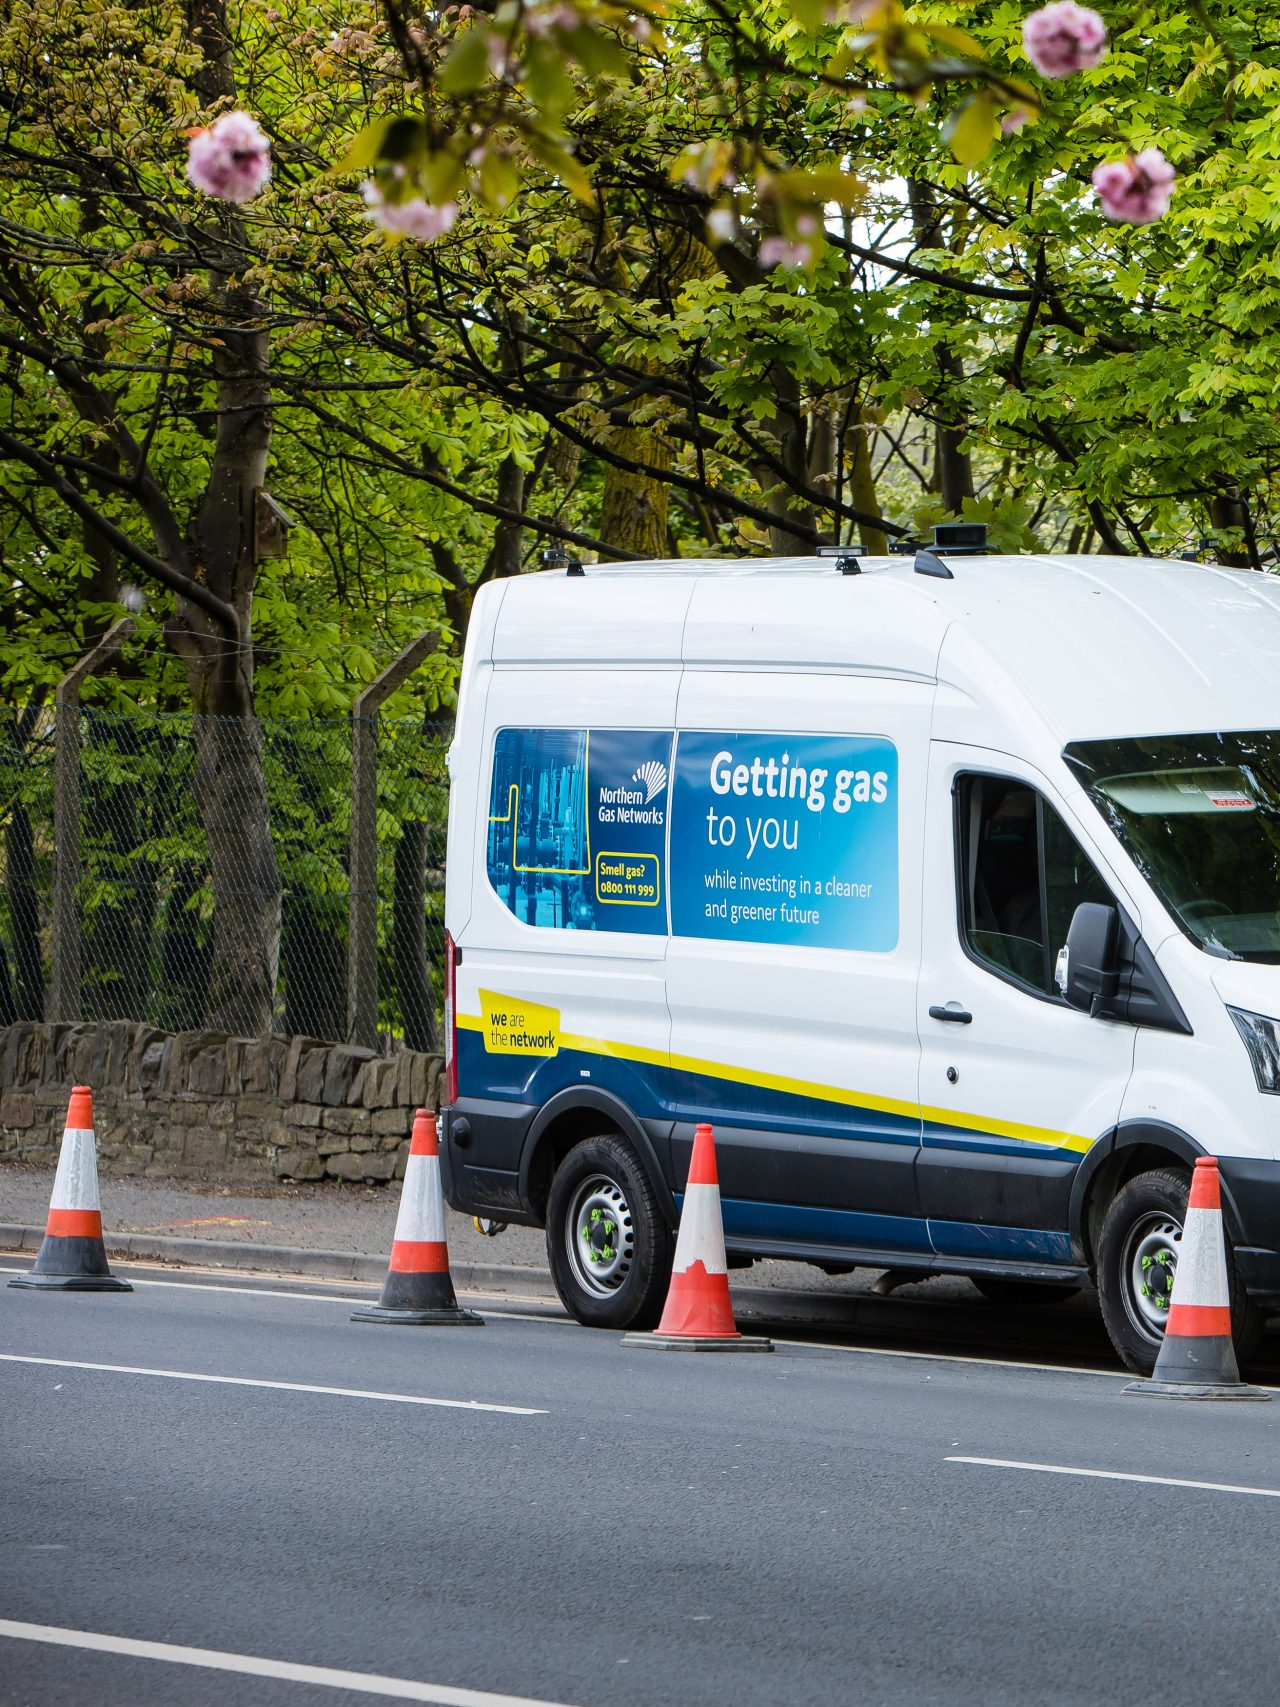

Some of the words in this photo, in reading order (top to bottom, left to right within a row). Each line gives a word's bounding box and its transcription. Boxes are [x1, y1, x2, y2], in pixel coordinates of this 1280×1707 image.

[710, 750, 829, 812] Getting
[832, 769, 889, 814] gas
[599, 786, 643, 805] Northern
[598, 805, 615, 822] Gas
[617, 806, 664, 825] Networks
[706, 806, 736, 846] to
[746, 816, 799, 859] you
[600, 862, 624, 876] Smell
[626, 864, 645, 880] gas?
[600, 881, 623, 894] 0800
[624, 884, 636, 895] 111
[638, 884, 654, 896] 999
[704, 868, 737, 890] while
[740, 872, 797, 899] investing
[800, 875, 811, 894] in
[814, 881, 822, 895] a
[825, 876, 872, 898] cleaner
[705, 898, 727, 918] and
[730, 904, 778, 924] greener
[780, 903, 820, 925] future
[491, 1013, 507, 1027] we
[509, 1014, 525, 1027] are
[491, 1028, 508, 1046] the
[509, 1030, 555, 1049] network
